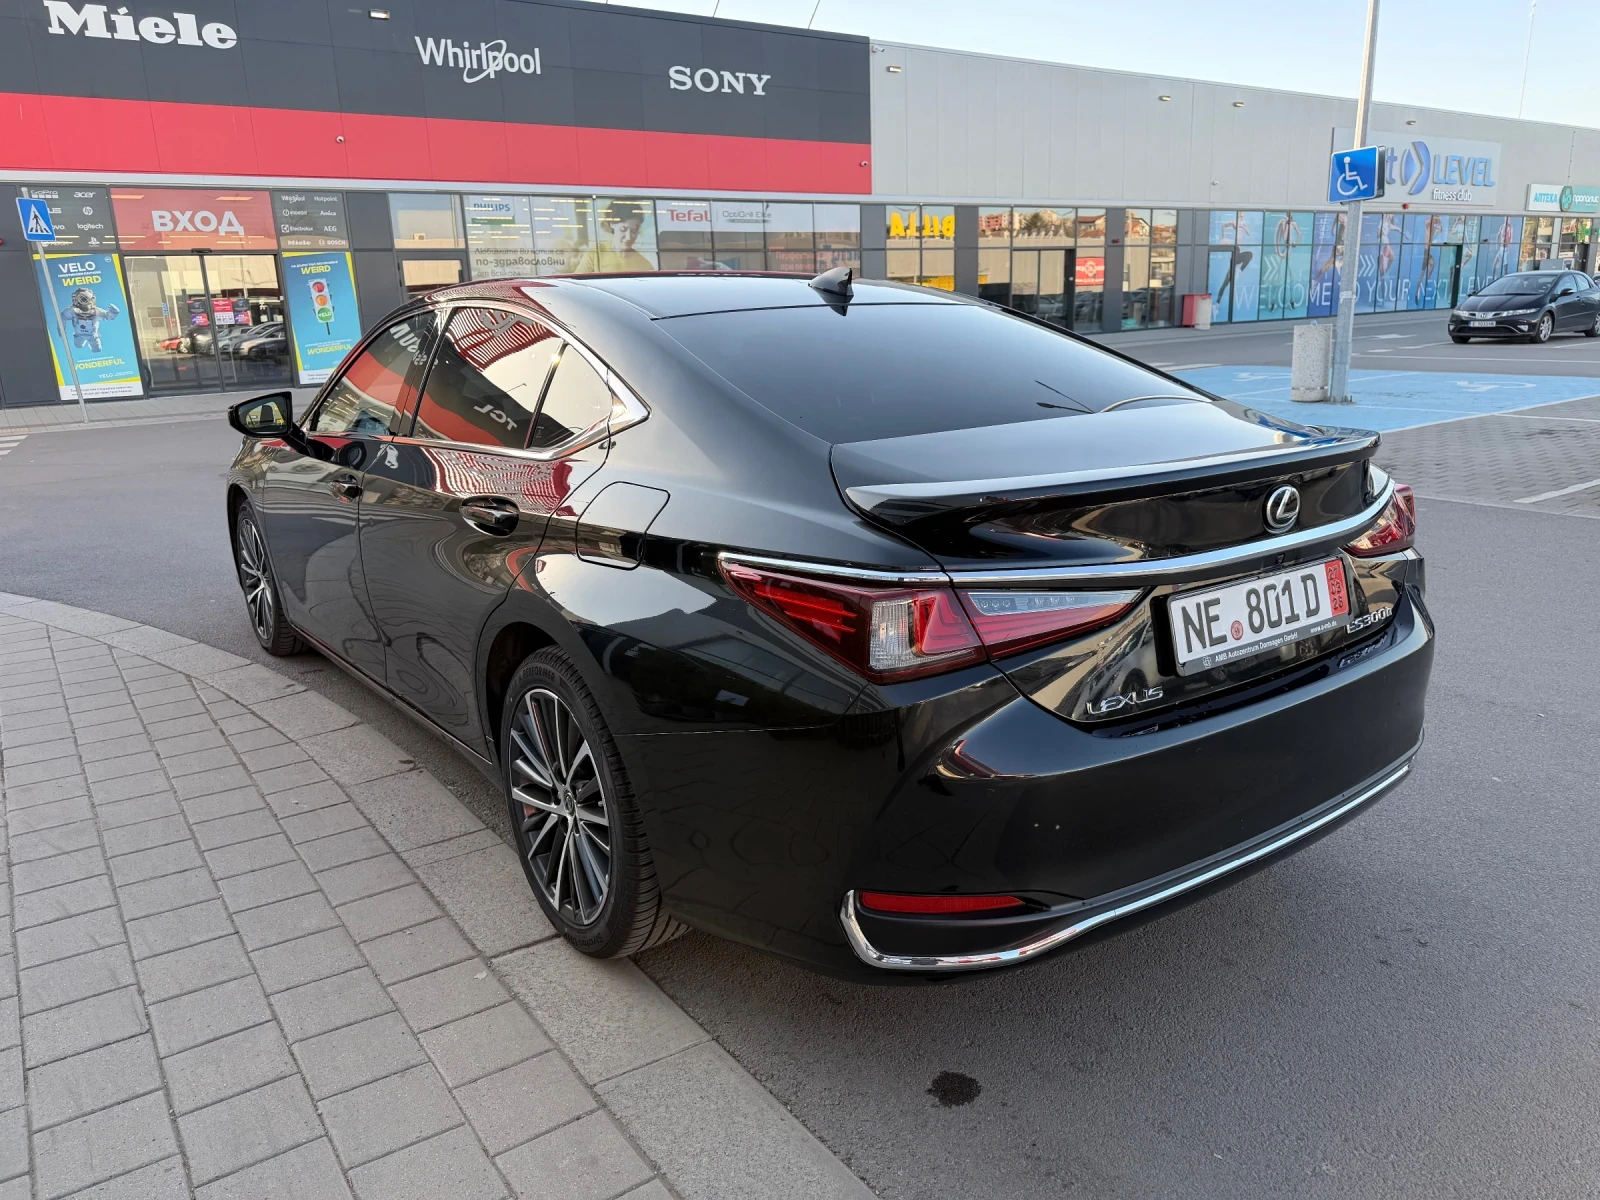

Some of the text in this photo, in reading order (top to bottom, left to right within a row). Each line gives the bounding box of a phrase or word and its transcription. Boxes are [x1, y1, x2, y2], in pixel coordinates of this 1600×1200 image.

[43, 1, 237, 49] Miele
[414, 36, 541, 83] Whirlpool
[668, 65, 771, 96] SONY
[1433, 154, 1496, 187] LEVEL
[281, 194, 306, 203] Whirlpool
[1433, 188, 1473, 201] fitness club
[1533, 193, 1558, 203] АПТЕКА
[473, 203, 511, 212] PHILIPS
[667, 209, 712, 222] Tefal
[722, 210, 754, 219] OptiGrill
[77, 223, 104, 231] logitech
[151, 210, 245, 236] ВХОД
[58, 261, 96, 274] VELO
[475, 256, 565, 268] по-здравословни
[300, 264, 332, 275] WEIRD
[62, 275, 102, 287] WEIRD
[1233, 280, 1332, 311] WELCOME
[1366, 278, 1412, 303] YOUR
[1418, 278, 1449, 300] NEXT
[1181, 573, 1320, 653] NE 801 D
[1346, 606, 1393, 634] ES300h
[1215, 632, 1298, 663] AMB Autozentrum Dormagen GmbH
[1086, 685, 1164, 714] LEXUS
